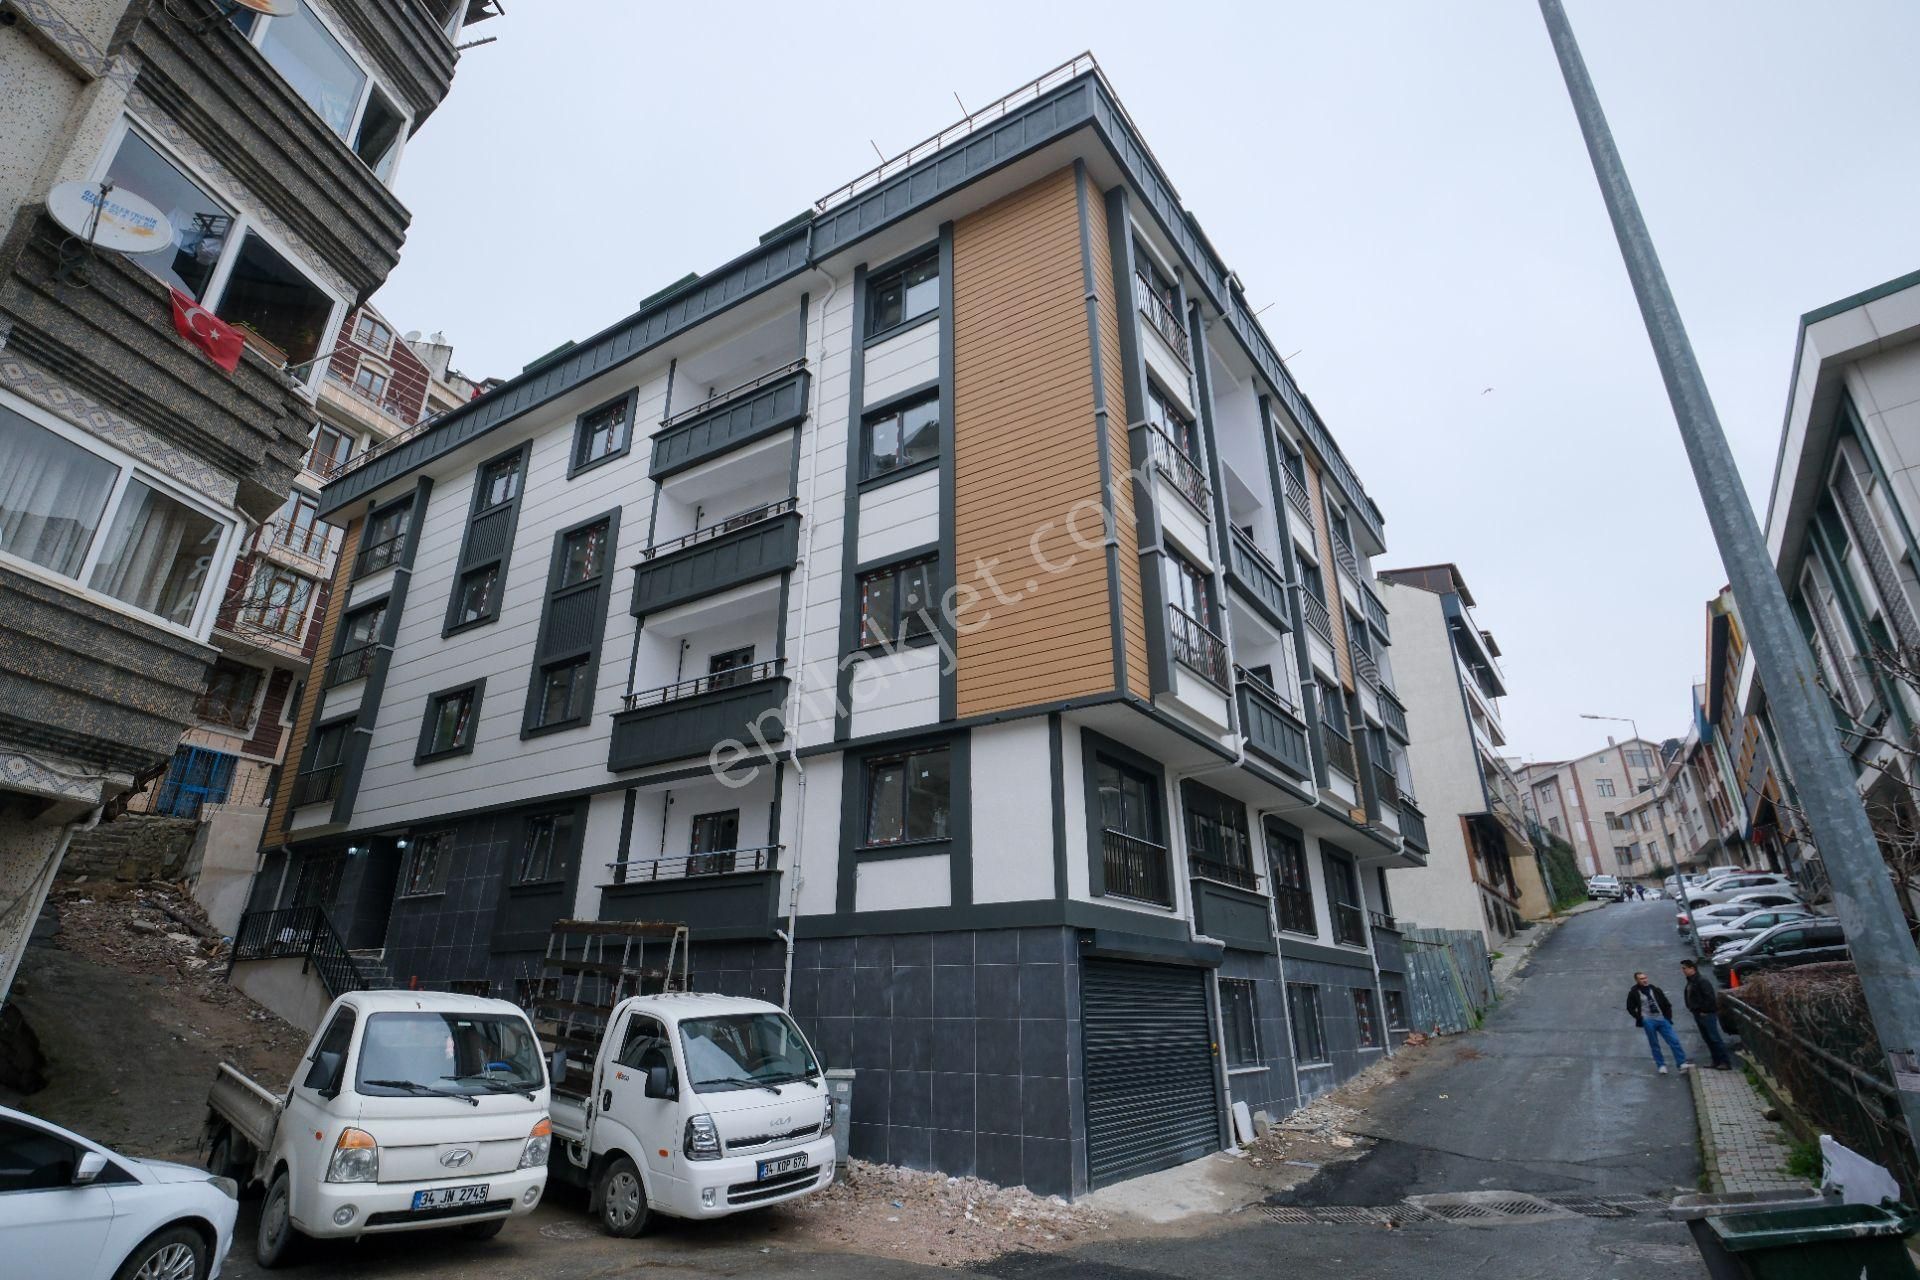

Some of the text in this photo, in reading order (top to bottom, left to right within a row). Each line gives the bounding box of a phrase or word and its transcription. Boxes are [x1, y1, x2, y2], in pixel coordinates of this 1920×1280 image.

[765, 1164, 773, 1175] 34
[793, 1156, 807, 1169] 672
[420, 1186, 487, 1205] 34 JN 2745
